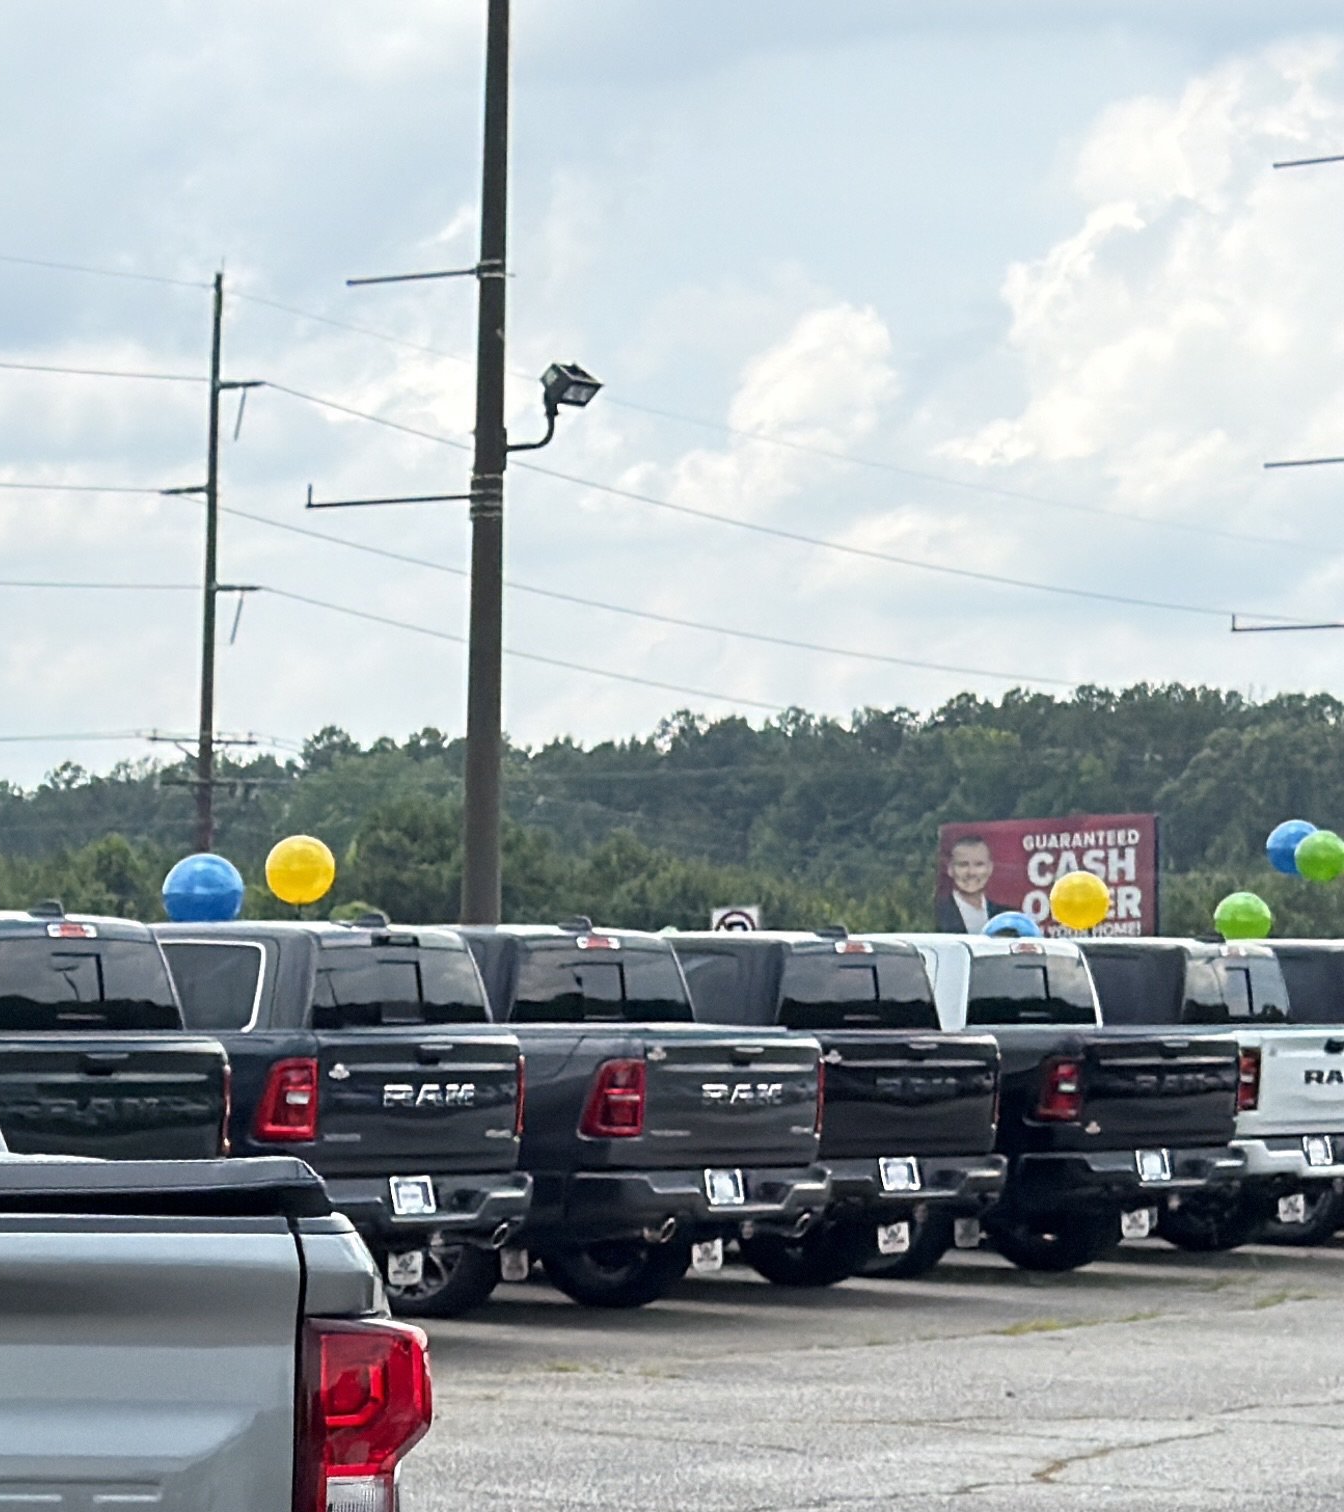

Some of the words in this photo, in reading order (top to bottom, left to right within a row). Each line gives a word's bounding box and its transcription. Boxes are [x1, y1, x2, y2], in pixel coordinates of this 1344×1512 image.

[1023, 829, 1140, 851] GUARANTEED
[1027, 847, 1137, 887] CASH
[383, 1083, 475, 1107] RAM
